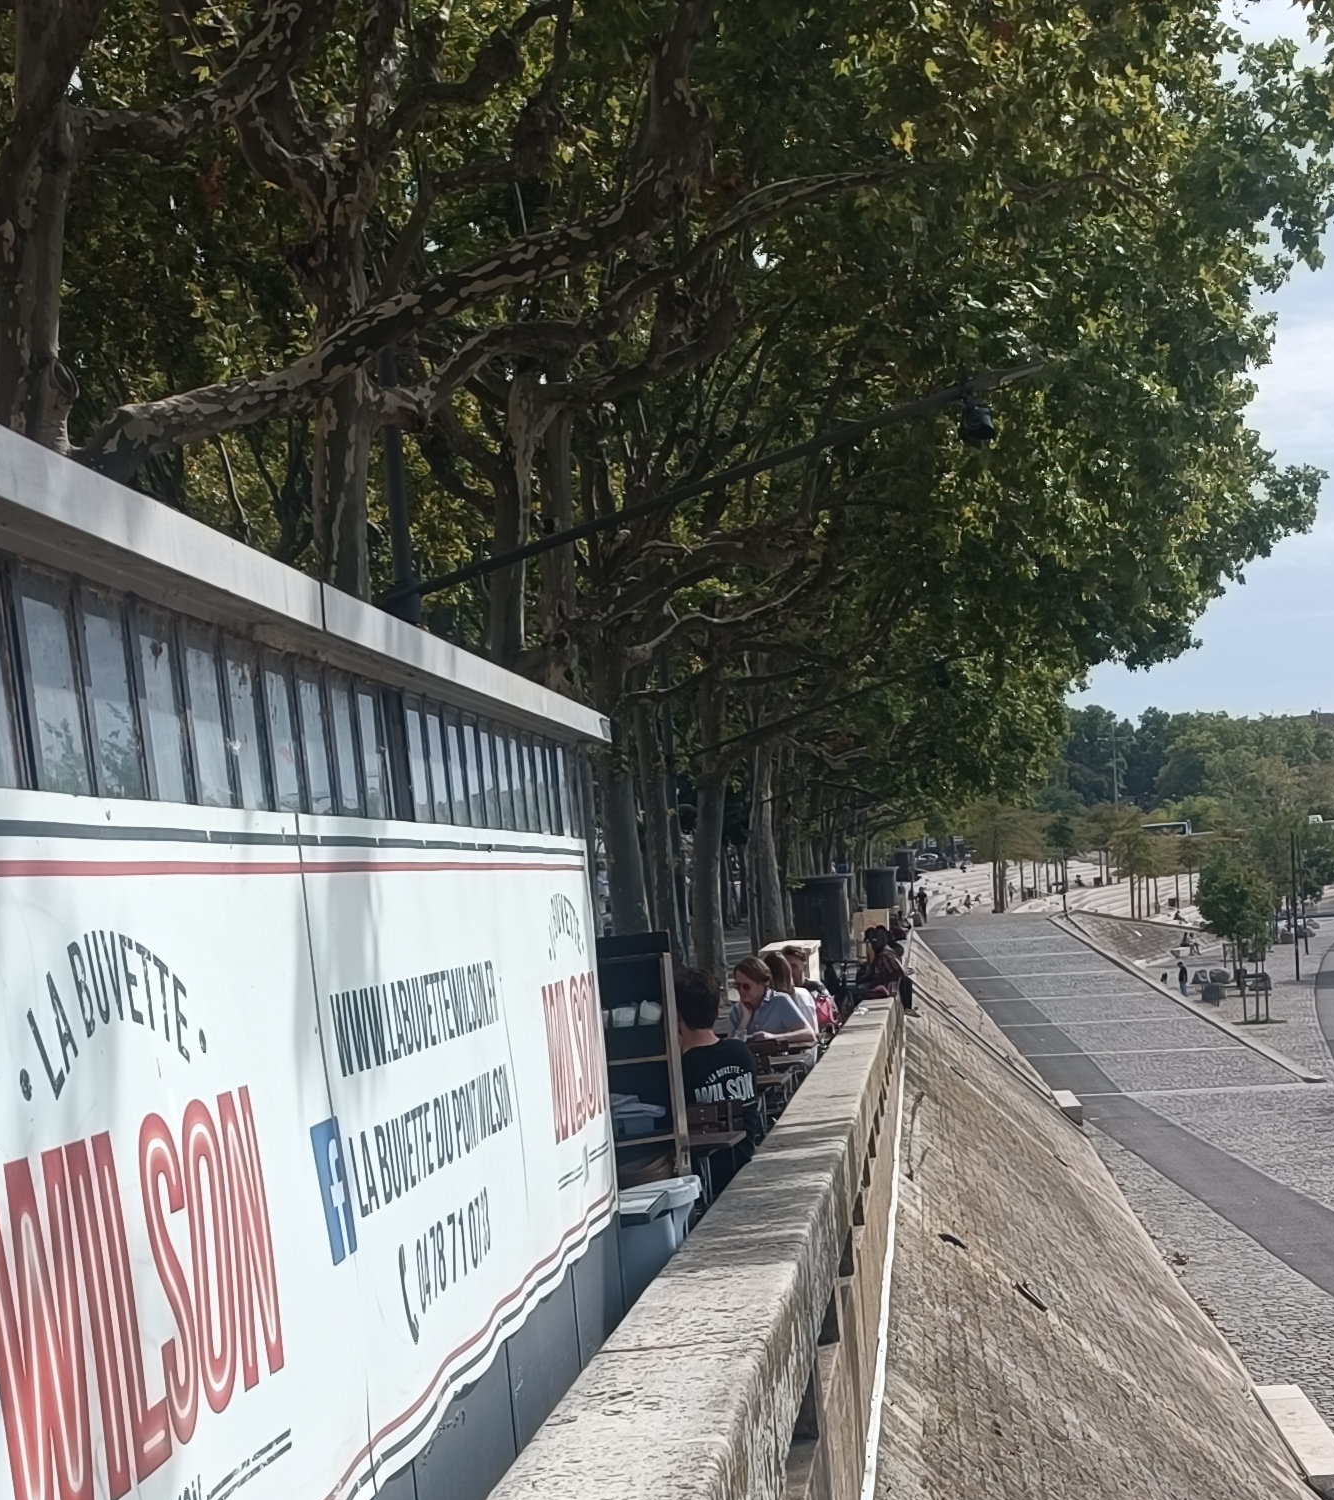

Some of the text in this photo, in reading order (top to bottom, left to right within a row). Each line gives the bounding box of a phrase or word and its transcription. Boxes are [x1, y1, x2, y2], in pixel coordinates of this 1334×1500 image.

[27, 971, 78, 1100] LA
[67, 929, 190, 1063] BUVETTE
[541, 970, 607, 1145] WILSON
[694, 1071, 755, 1104] WILSON
[348, 1062, 514, 1218] LA BUVETTE DU PONT WILSON
